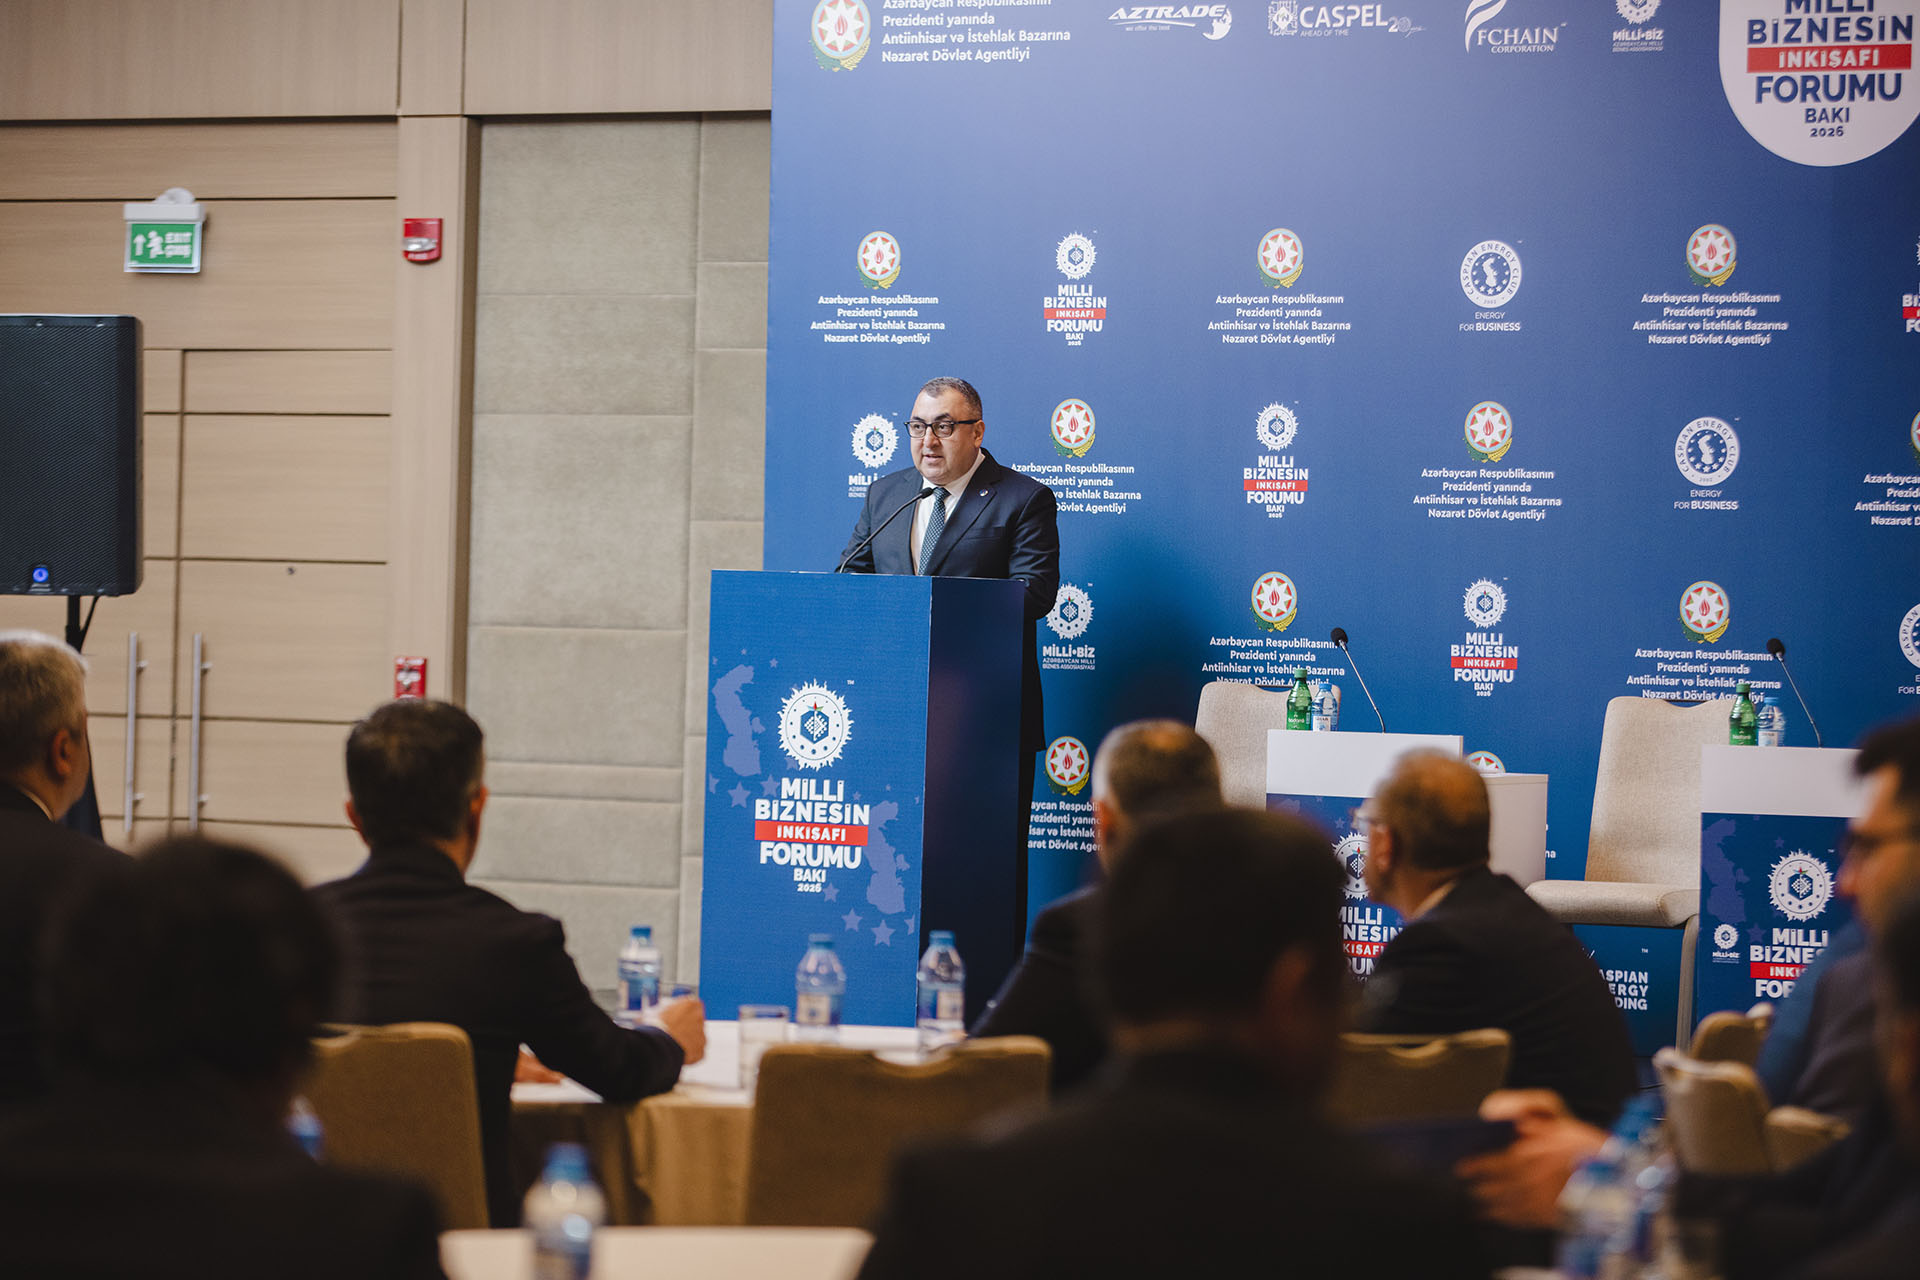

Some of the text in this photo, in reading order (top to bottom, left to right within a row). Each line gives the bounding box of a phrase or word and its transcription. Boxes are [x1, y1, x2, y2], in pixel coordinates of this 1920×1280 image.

[1108, 5, 1226, 20] AZTRADE
[1300, 4, 1388, 28] CASPEL
[1477, 27, 1559, 45] FCHAIN
[1491, 44, 1554, 54] CORPORATION
[1755, 73, 1902, 104] FORUMU
[1804, 107, 1850, 123] BAKI
[1810, 126, 1844, 137] 2026
[1462, 243, 1519, 295] CASPIAN ENERGY CLUB
[1047, 320, 1103, 332] FORUMU
[1476, 322, 1521, 331] BUSINESS
[1677, 420, 1736, 472] CASPIAN ENERGY CLUB
[1247, 491, 1304, 504] FORUMU
[1691, 501, 1739, 510] BUSINESS
[1454, 668, 1514, 683] FORUMU
[1474, 683, 1493, 691] BAKI
[760, 841, 862, 870] FORUMU
[794, 868, 826, 883] BAKI
[797, 883, 822, 893] 2026
